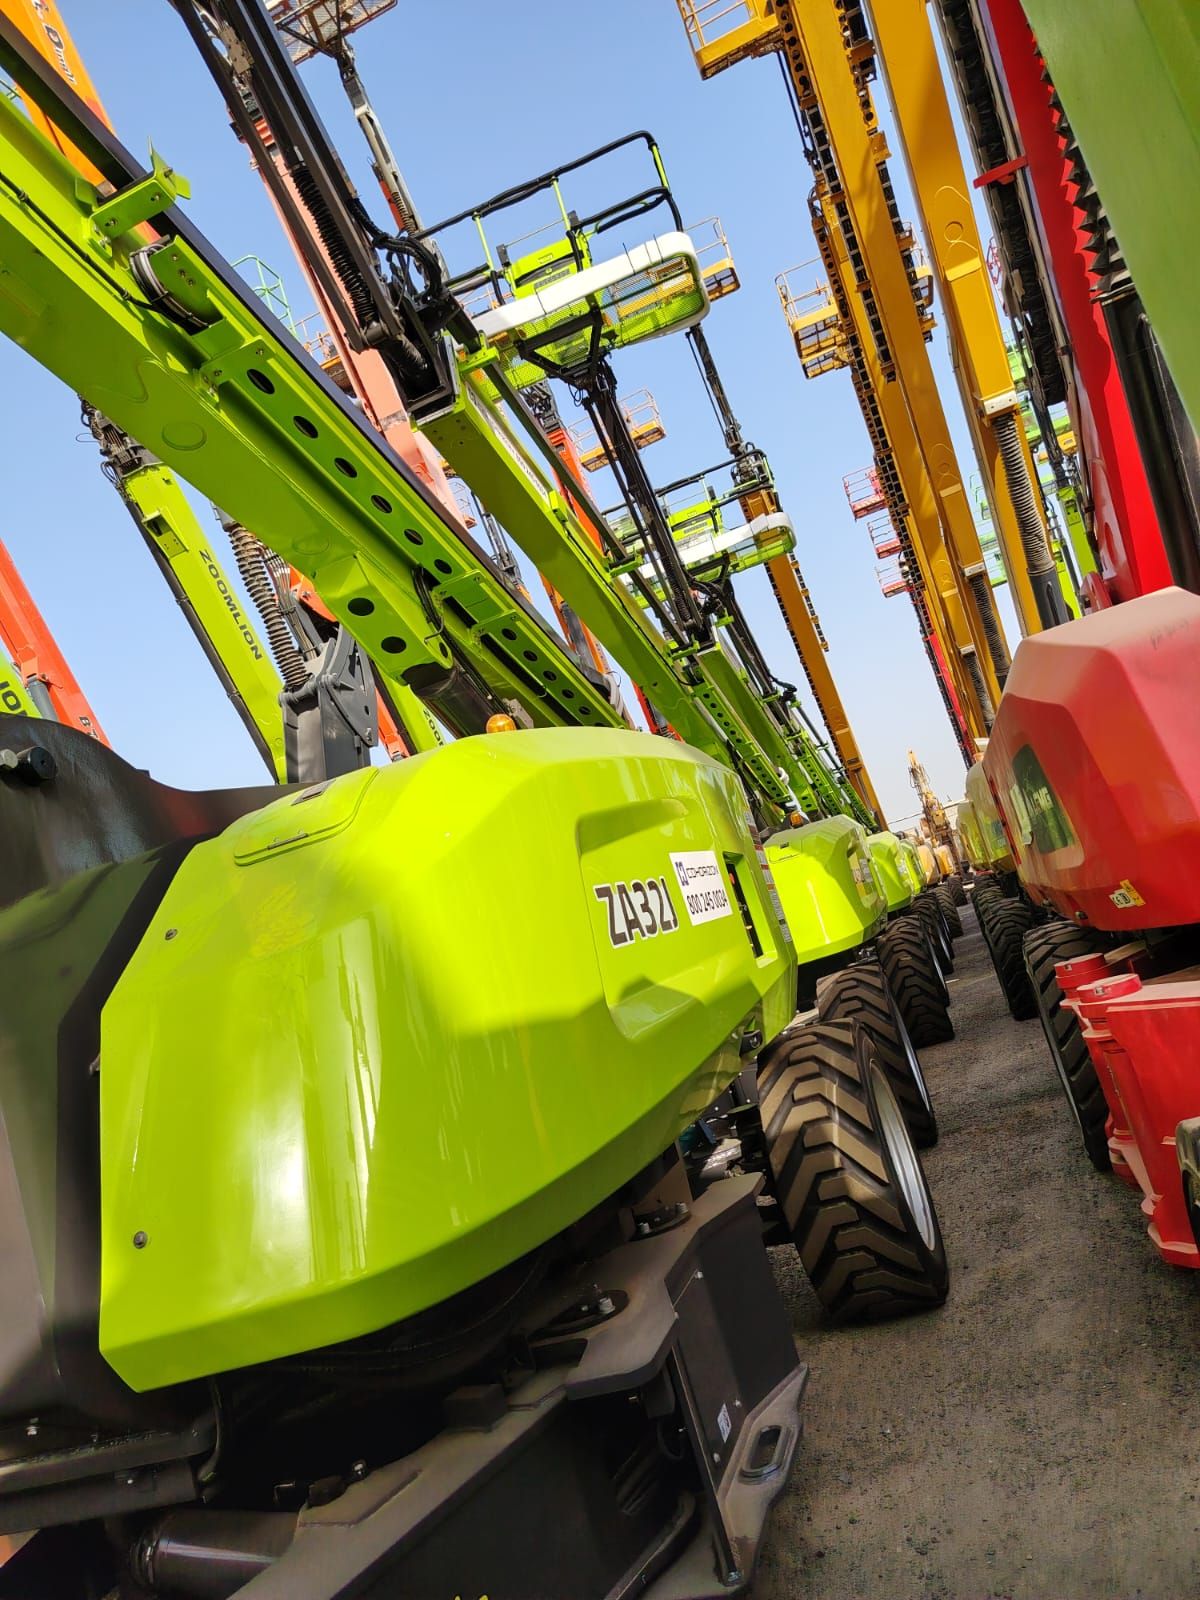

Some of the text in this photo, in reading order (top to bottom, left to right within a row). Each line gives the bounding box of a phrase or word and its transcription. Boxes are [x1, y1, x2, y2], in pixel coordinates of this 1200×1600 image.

[199, 549, 262, 660] ZOOMLION
[595, 877, 678, 946] ZA32J
[686, 892, 702, 915] 800
[700, 891, 715, 913] 245
